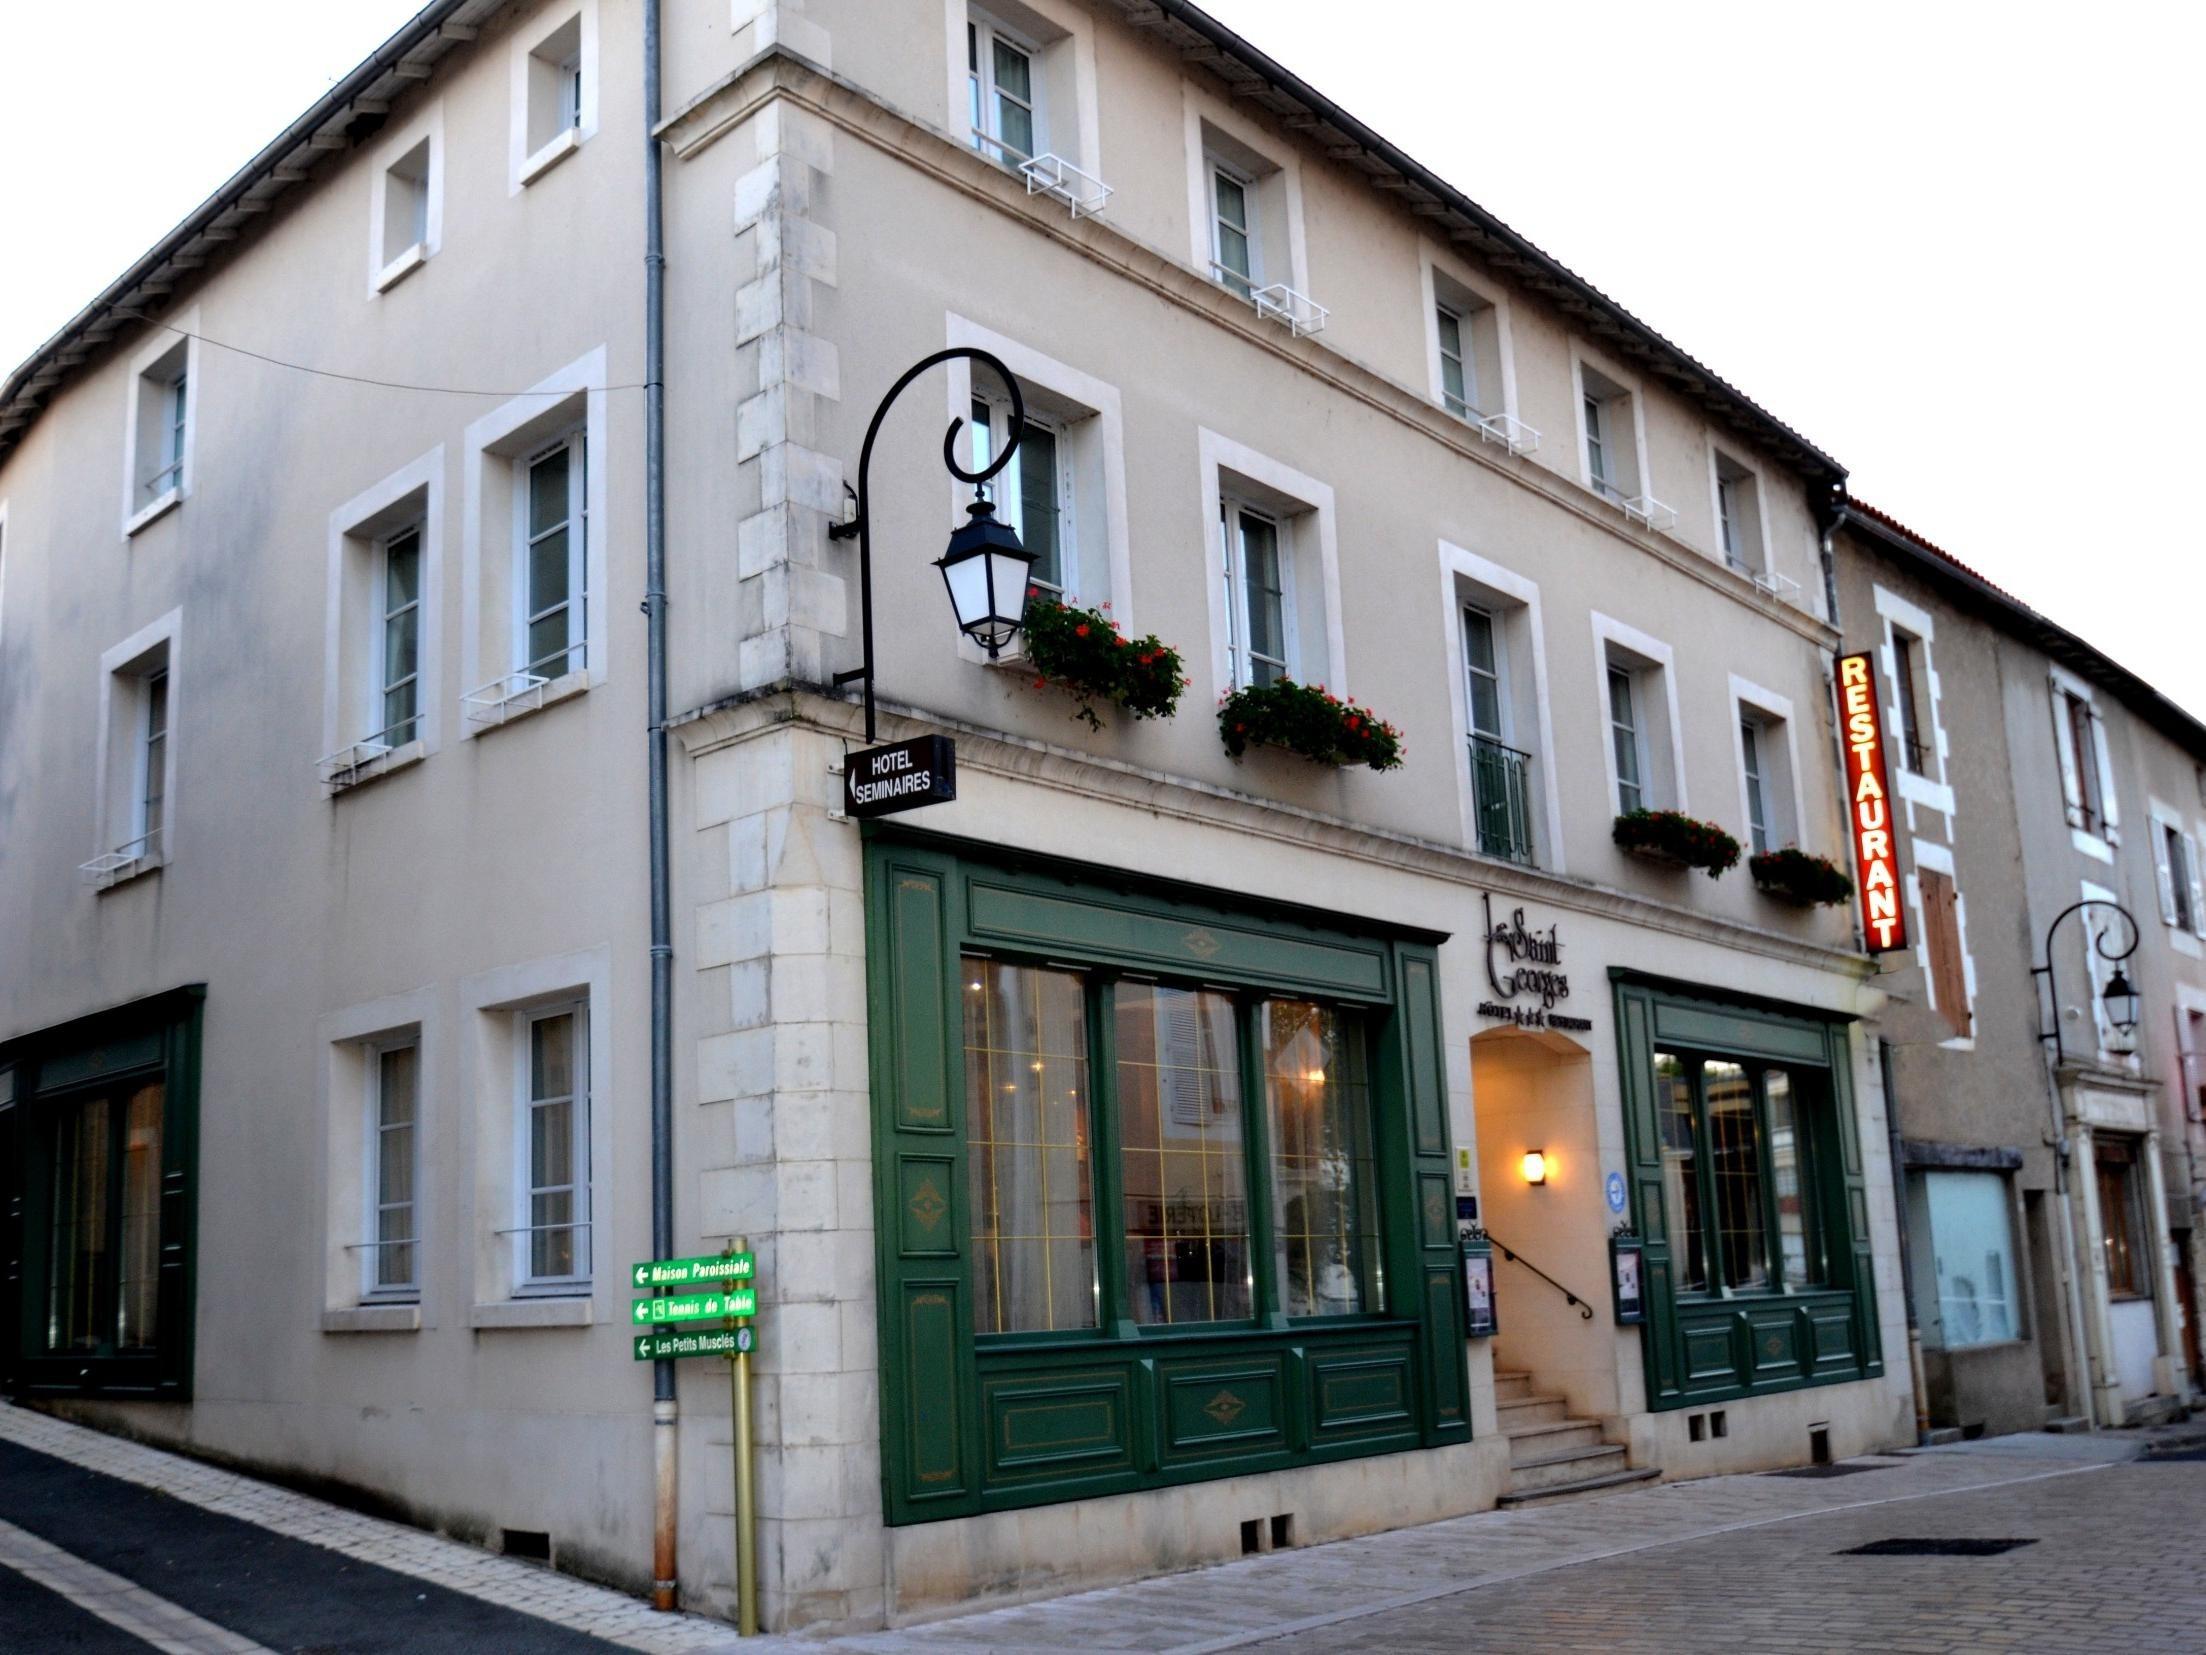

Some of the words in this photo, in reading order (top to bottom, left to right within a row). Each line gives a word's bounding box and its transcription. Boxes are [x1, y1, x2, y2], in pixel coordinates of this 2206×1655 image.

[872, 749, 913, 776] HOTEL
[856, 770, 931, 805] SEMINAIRES
[1840, 656, 1898, 948] RESTAURANT
[652, 1265, 688, 1282] Maison
[692, 1258, 750, 1278] Paroissiale
[668, 1301, 700, 1316] Tennis
[705, 1298, 718, 1314] de
[724, 1295, 753, 1311] Table
[656, 1339, 671, 1354] Les
[673, 1336, 697, 1352] Petits
[698, 1332, 735, 1351] Musclés
